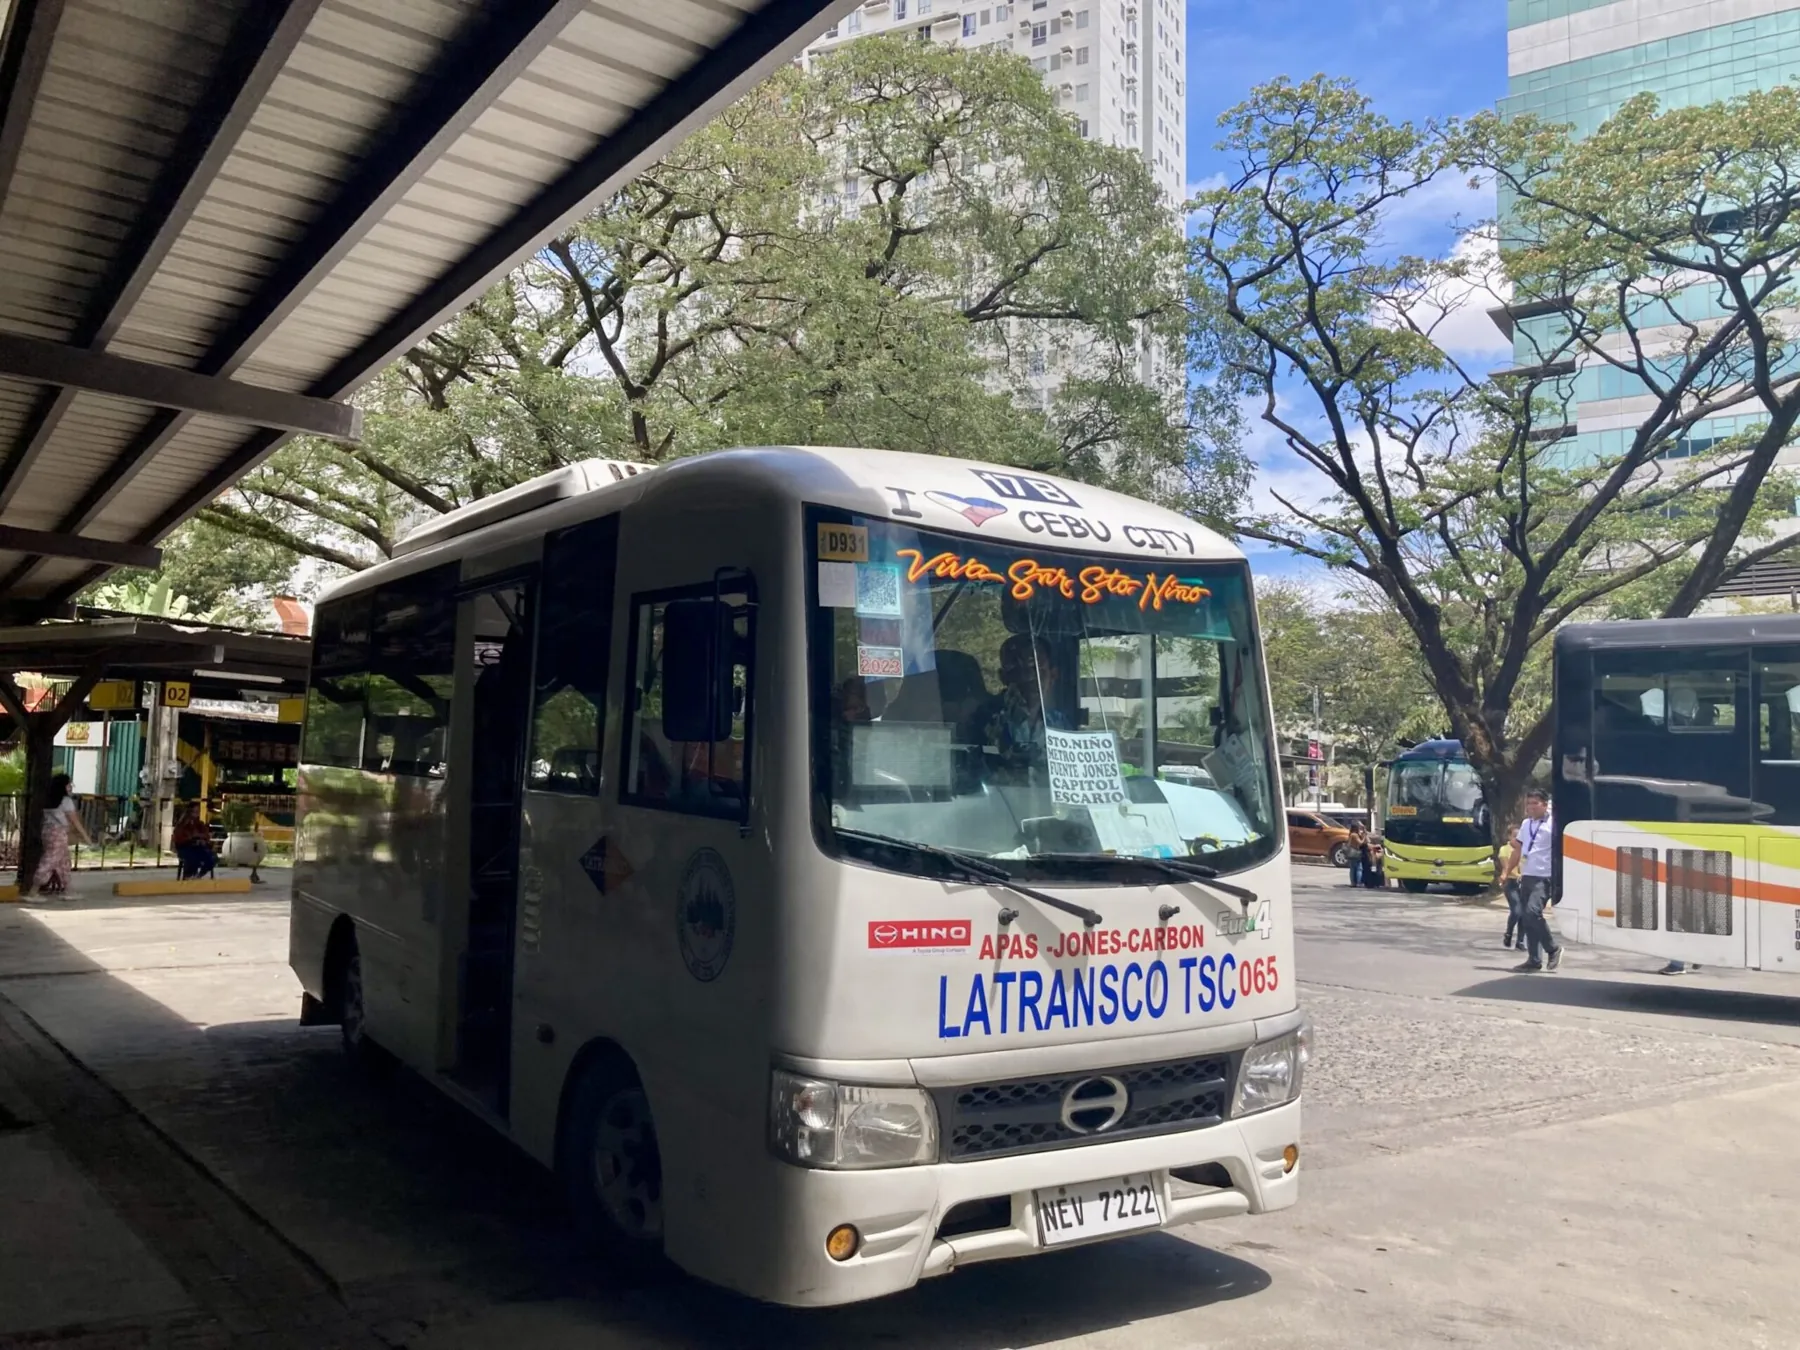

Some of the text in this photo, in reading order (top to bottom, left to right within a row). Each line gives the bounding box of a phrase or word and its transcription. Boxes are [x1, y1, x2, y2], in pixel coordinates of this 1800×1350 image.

[885, 486, 1195, 555] I CEBU CITY
[896, 549, 1006, 583] Viva
[860, 658, 901, 674] 2023
[167, 687, 186, 701] 02
[1047, 748, 1115, 763] METRO COLON
[1049, 761, 1118, 778] FUENTE JONES
[1052, 778, 1119, 791] CAPITOL
[1054, 790, 1125, 804] ESCARIO
[902, 927, 967, 940] HINO
[979, 933, 1038, 960] APAS
[938, 953, 1278, 1038] LATRANSCO TSC 065
[1042, 1185, 1155, 1232] NEV 7222
